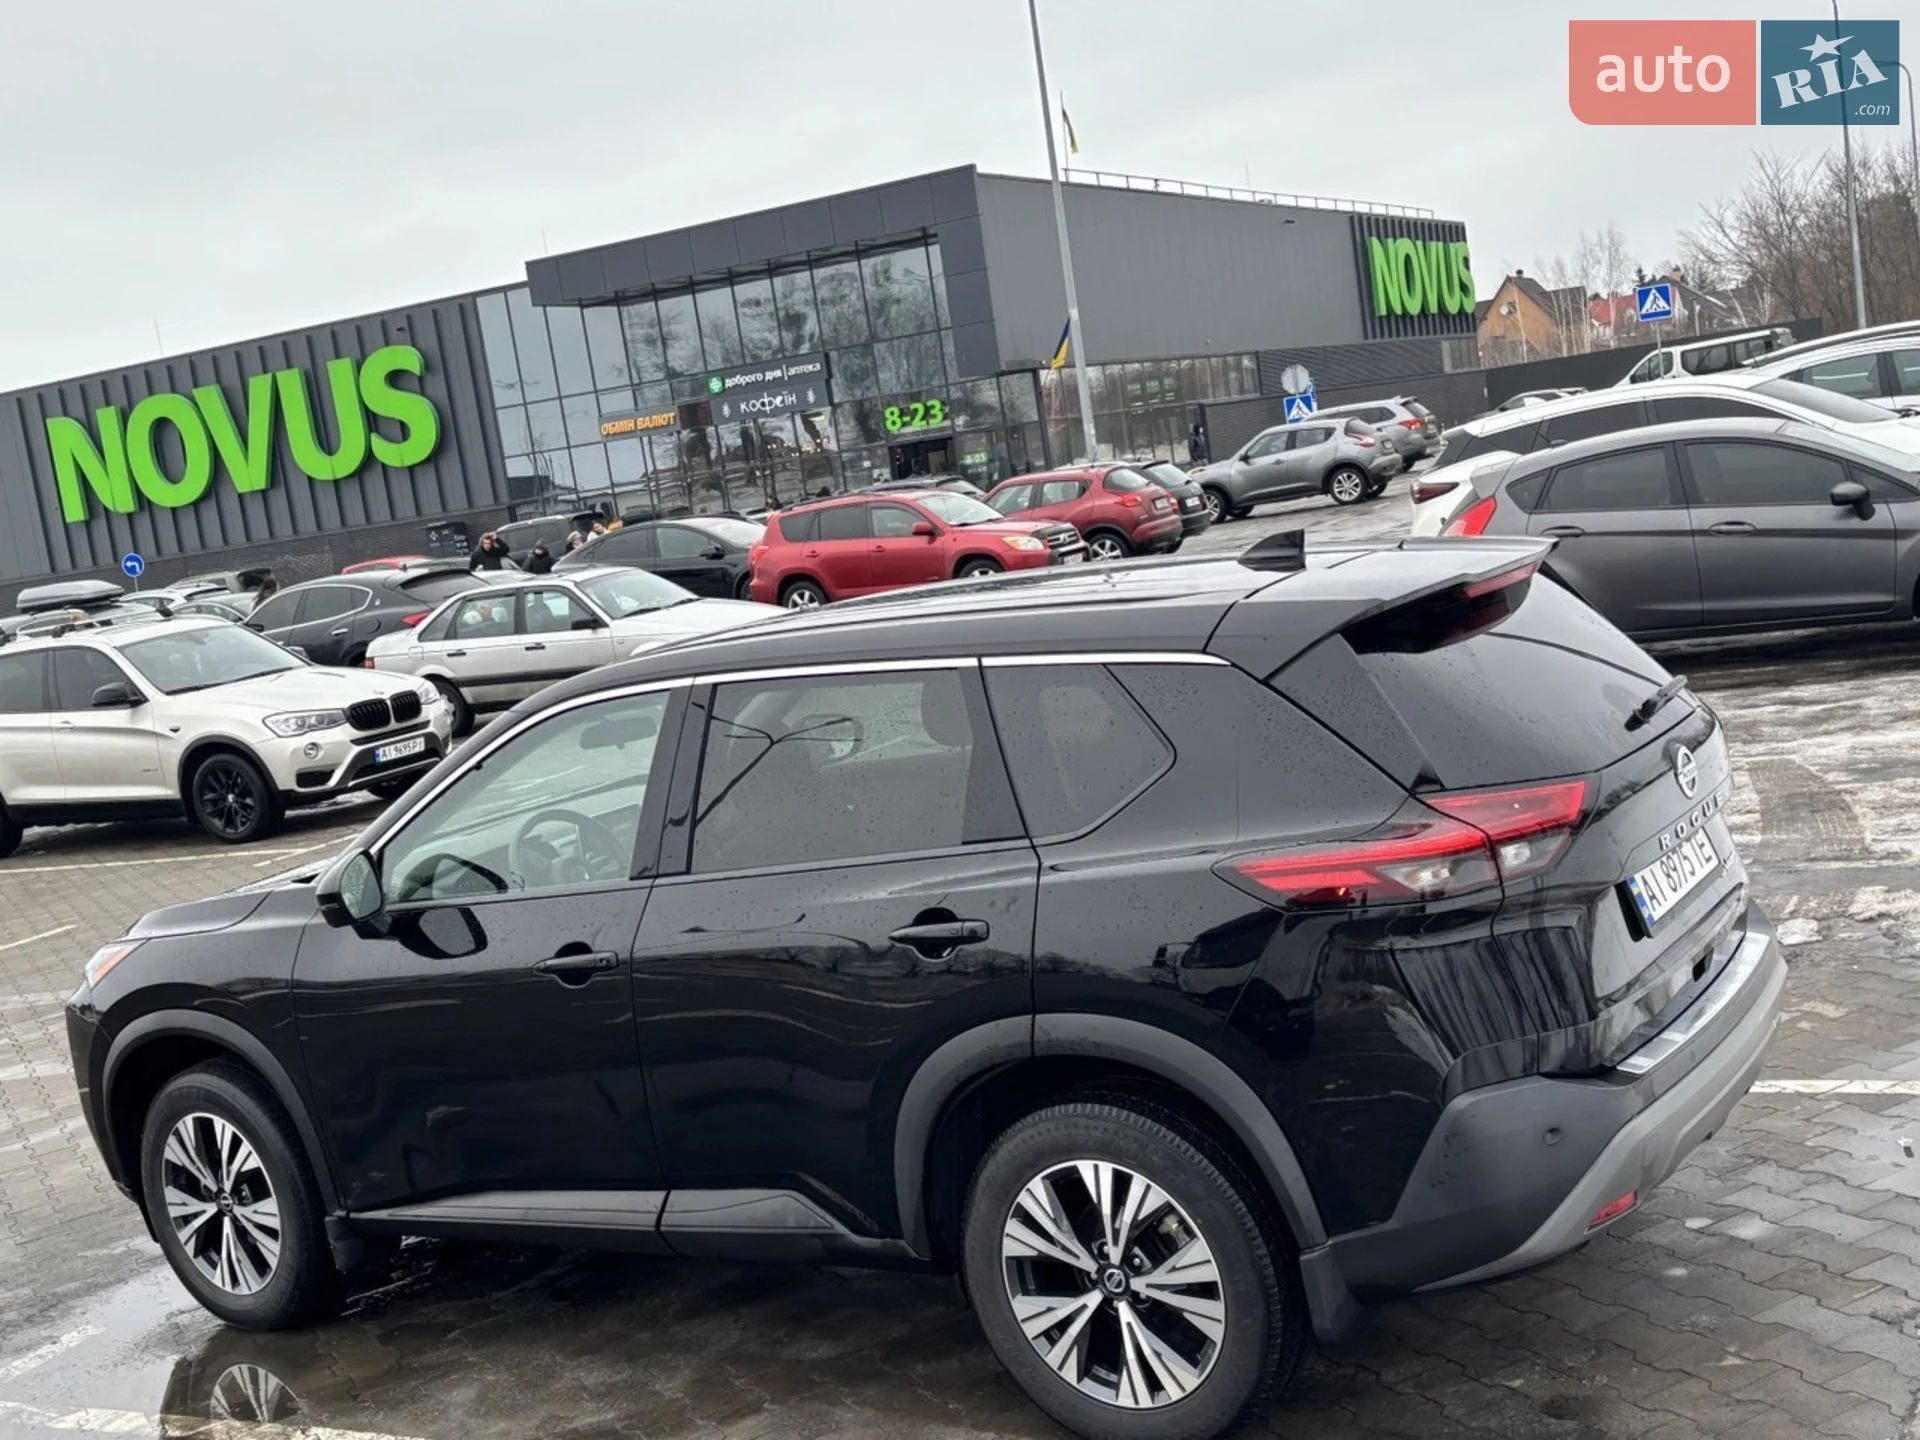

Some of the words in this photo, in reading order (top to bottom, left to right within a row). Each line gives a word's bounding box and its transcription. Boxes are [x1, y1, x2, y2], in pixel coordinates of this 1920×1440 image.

[1368, 236, 1476, 317] NOVUS
[46, 344, 440, 524] NOVUS
[601, 419, 635, 435] ОБМІН
[636, 412, 675, 429] ВАЛЮТ
[884, 398, 944, 433] 8-23
[1659, 791, 1723, 851] ROGUE
